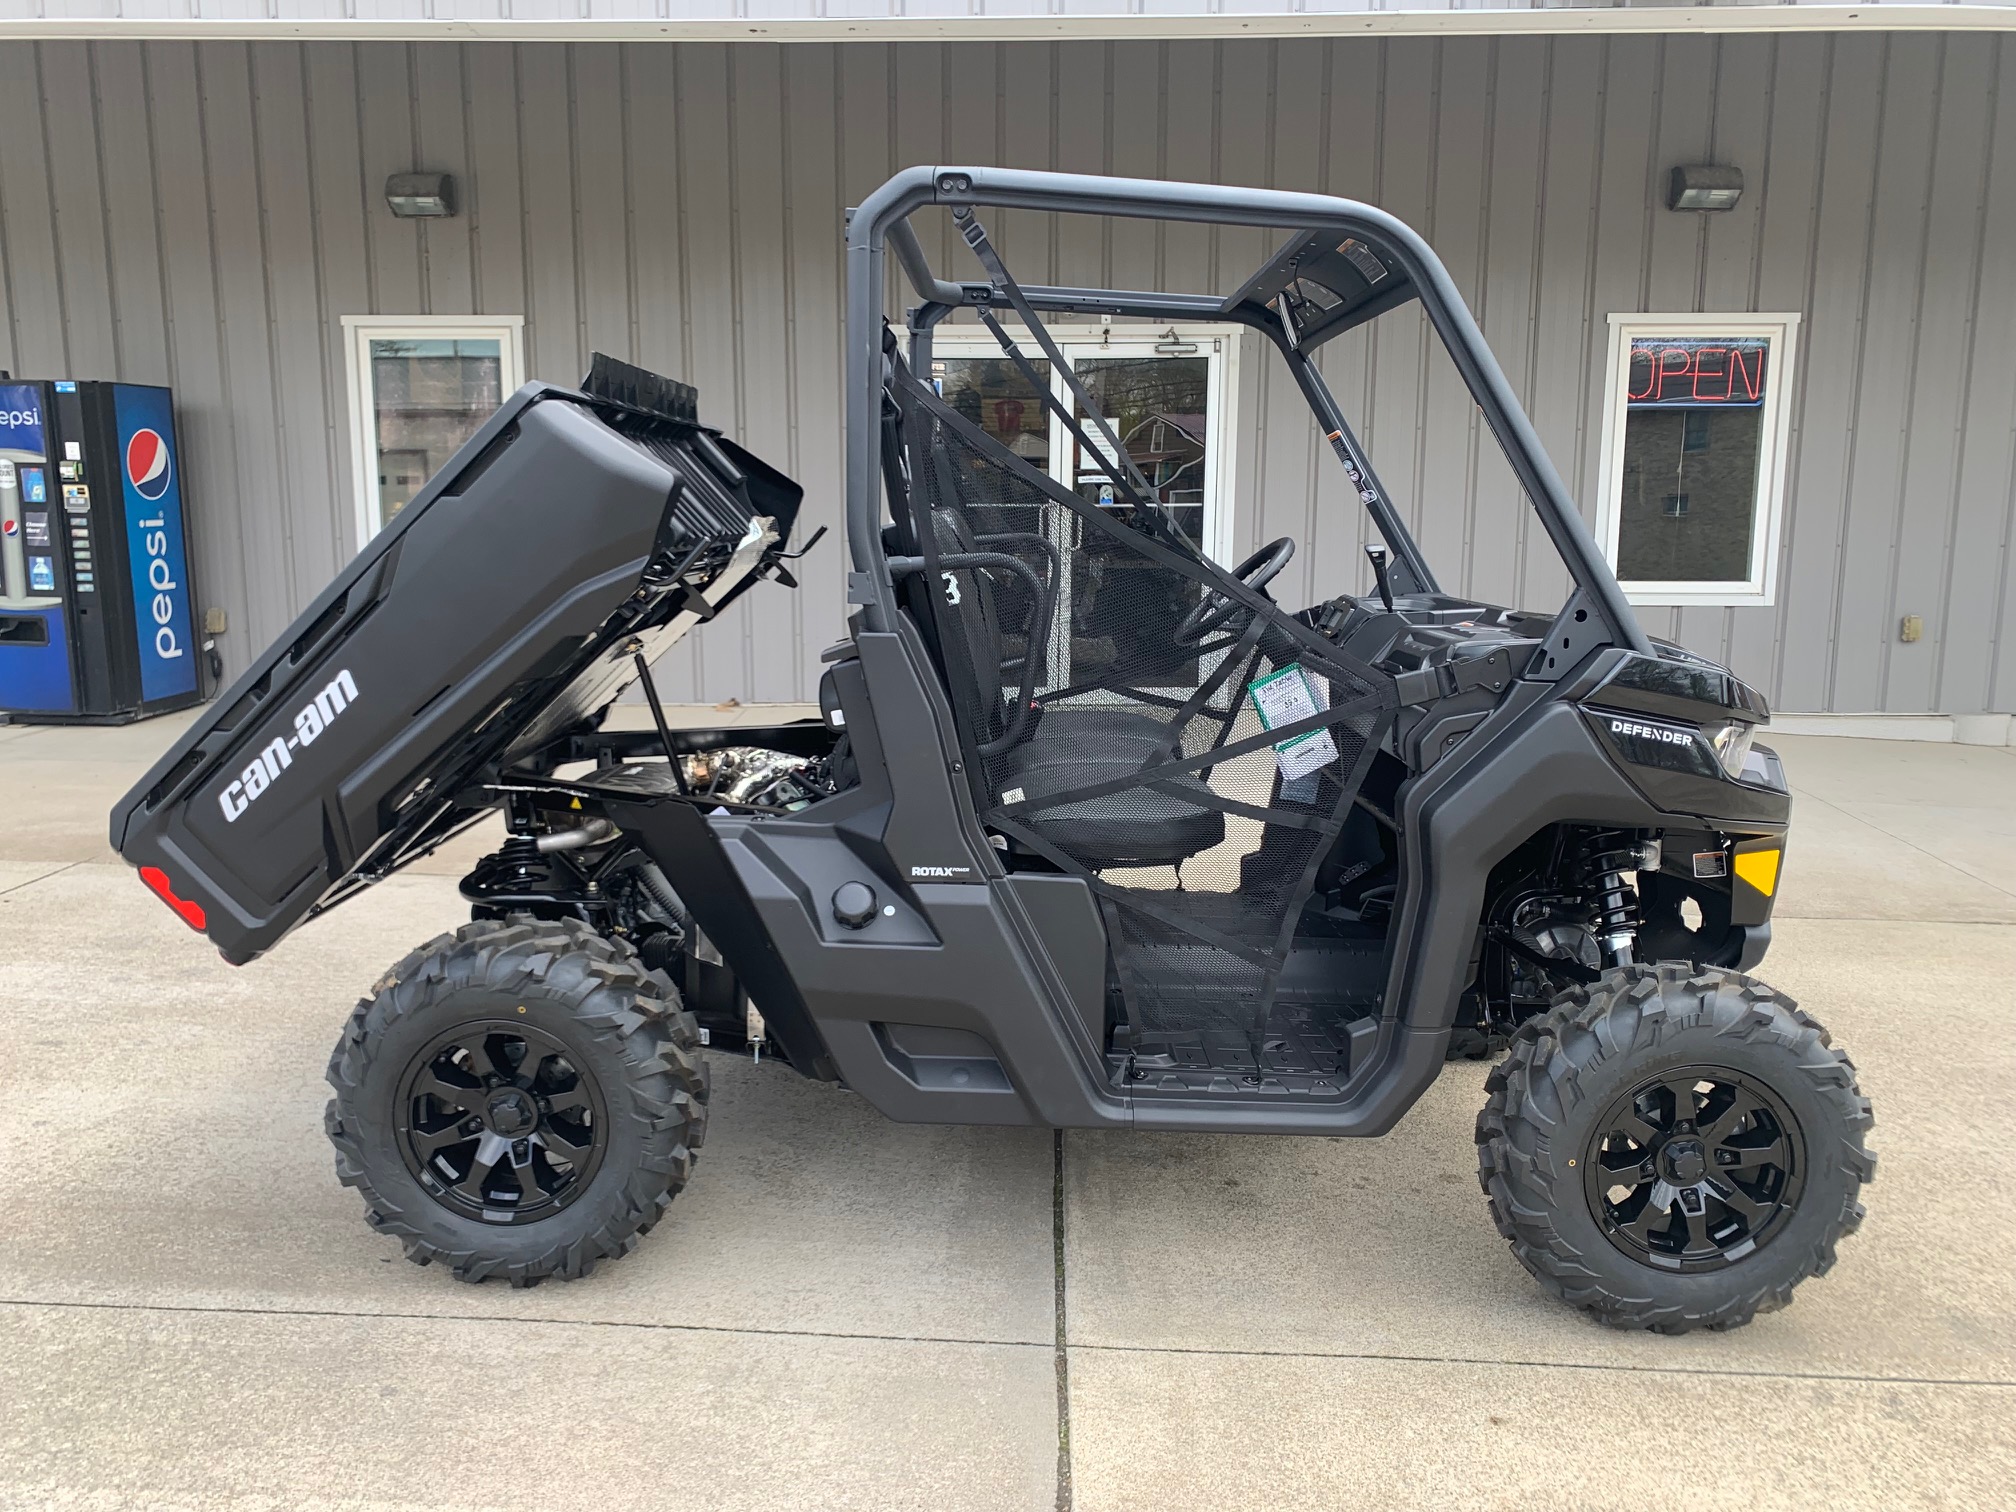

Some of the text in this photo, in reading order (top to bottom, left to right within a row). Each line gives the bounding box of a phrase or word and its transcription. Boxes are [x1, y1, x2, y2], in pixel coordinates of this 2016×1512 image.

[1628, 348, 1764, 400] OPEN
[138, 518, 183, 660] pepsi
[218, 669, 359, 823] can-am
[1611, 720, 1693, 746] DEFENDER
[911, 866, 953, 876] ROTAX
